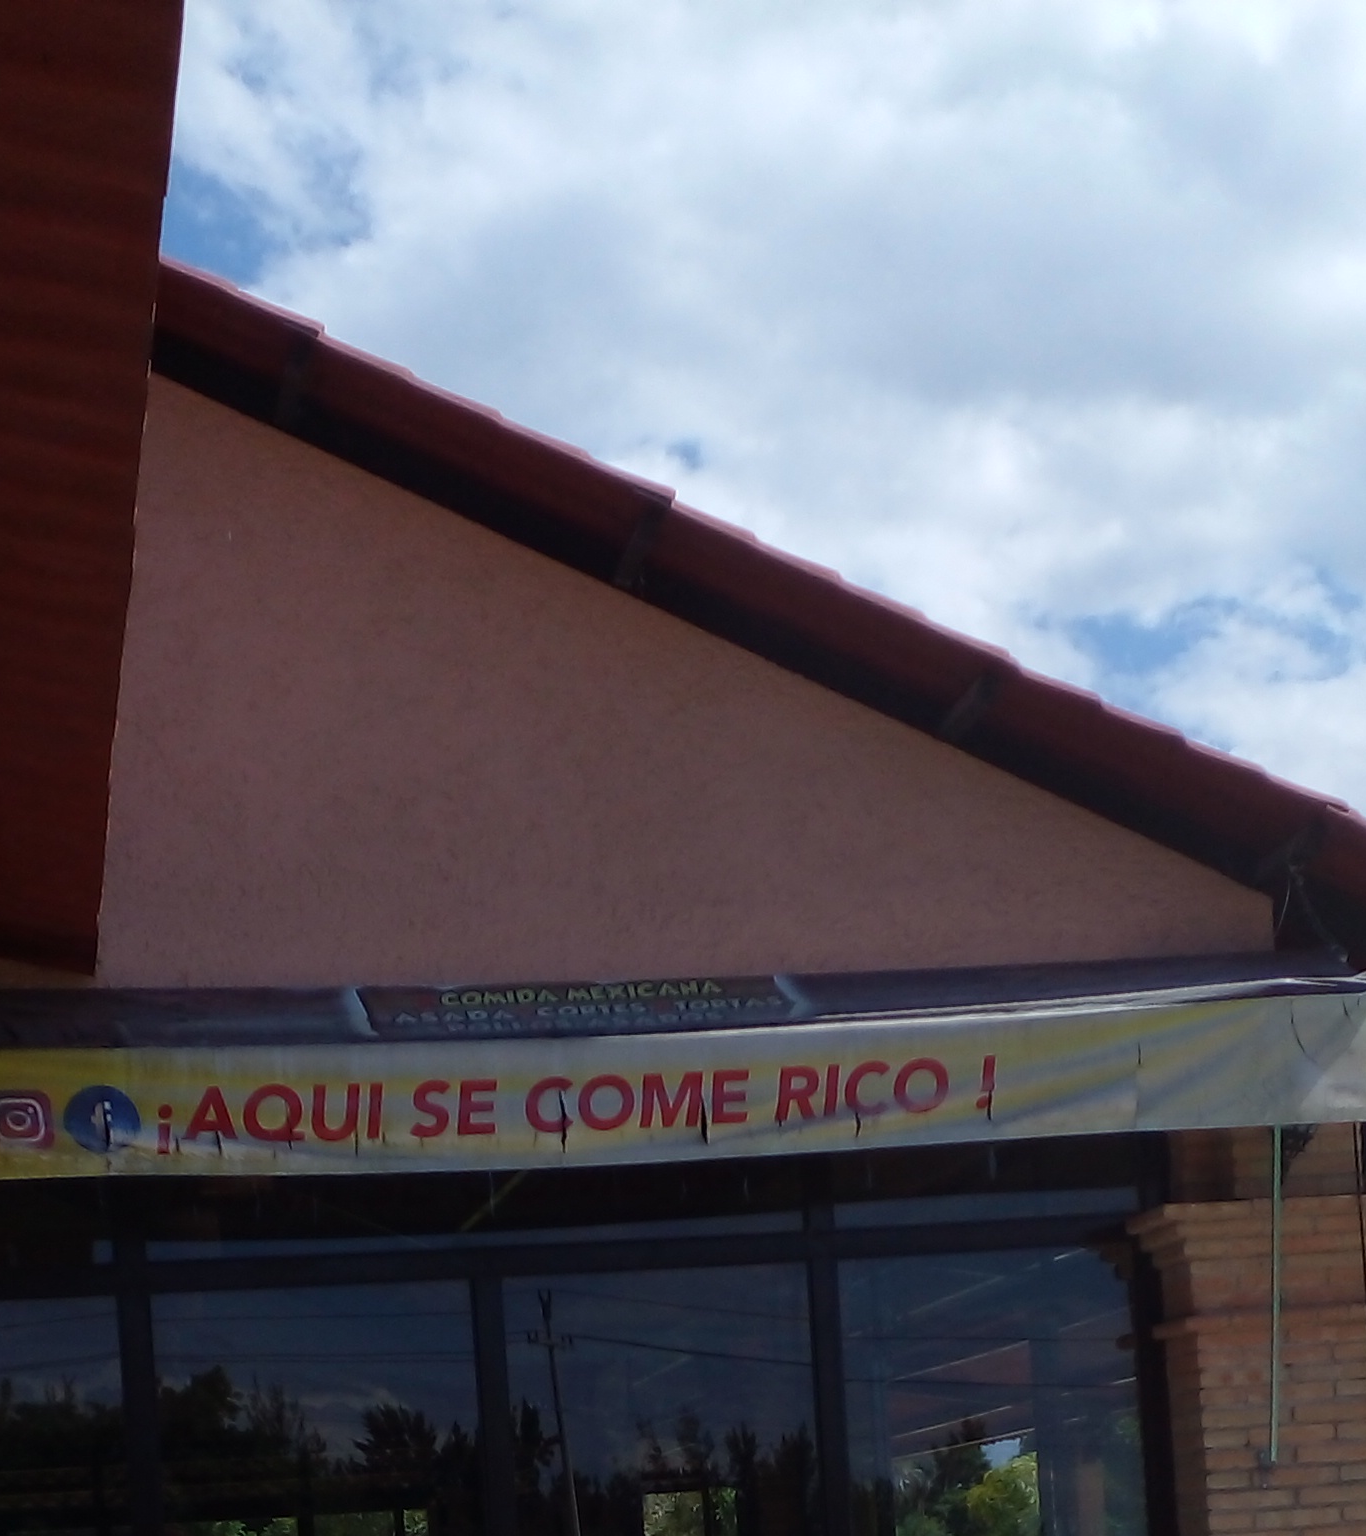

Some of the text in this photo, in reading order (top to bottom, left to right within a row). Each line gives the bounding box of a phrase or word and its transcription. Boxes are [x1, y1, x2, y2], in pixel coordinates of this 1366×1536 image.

[439, 978, 723, 1006] COMIDA MEXICANA
[411, 1079, 498, 1138] SE
[524, 1069, 752, 1134] COME
[775, 1057, 950, 1121] RICO
